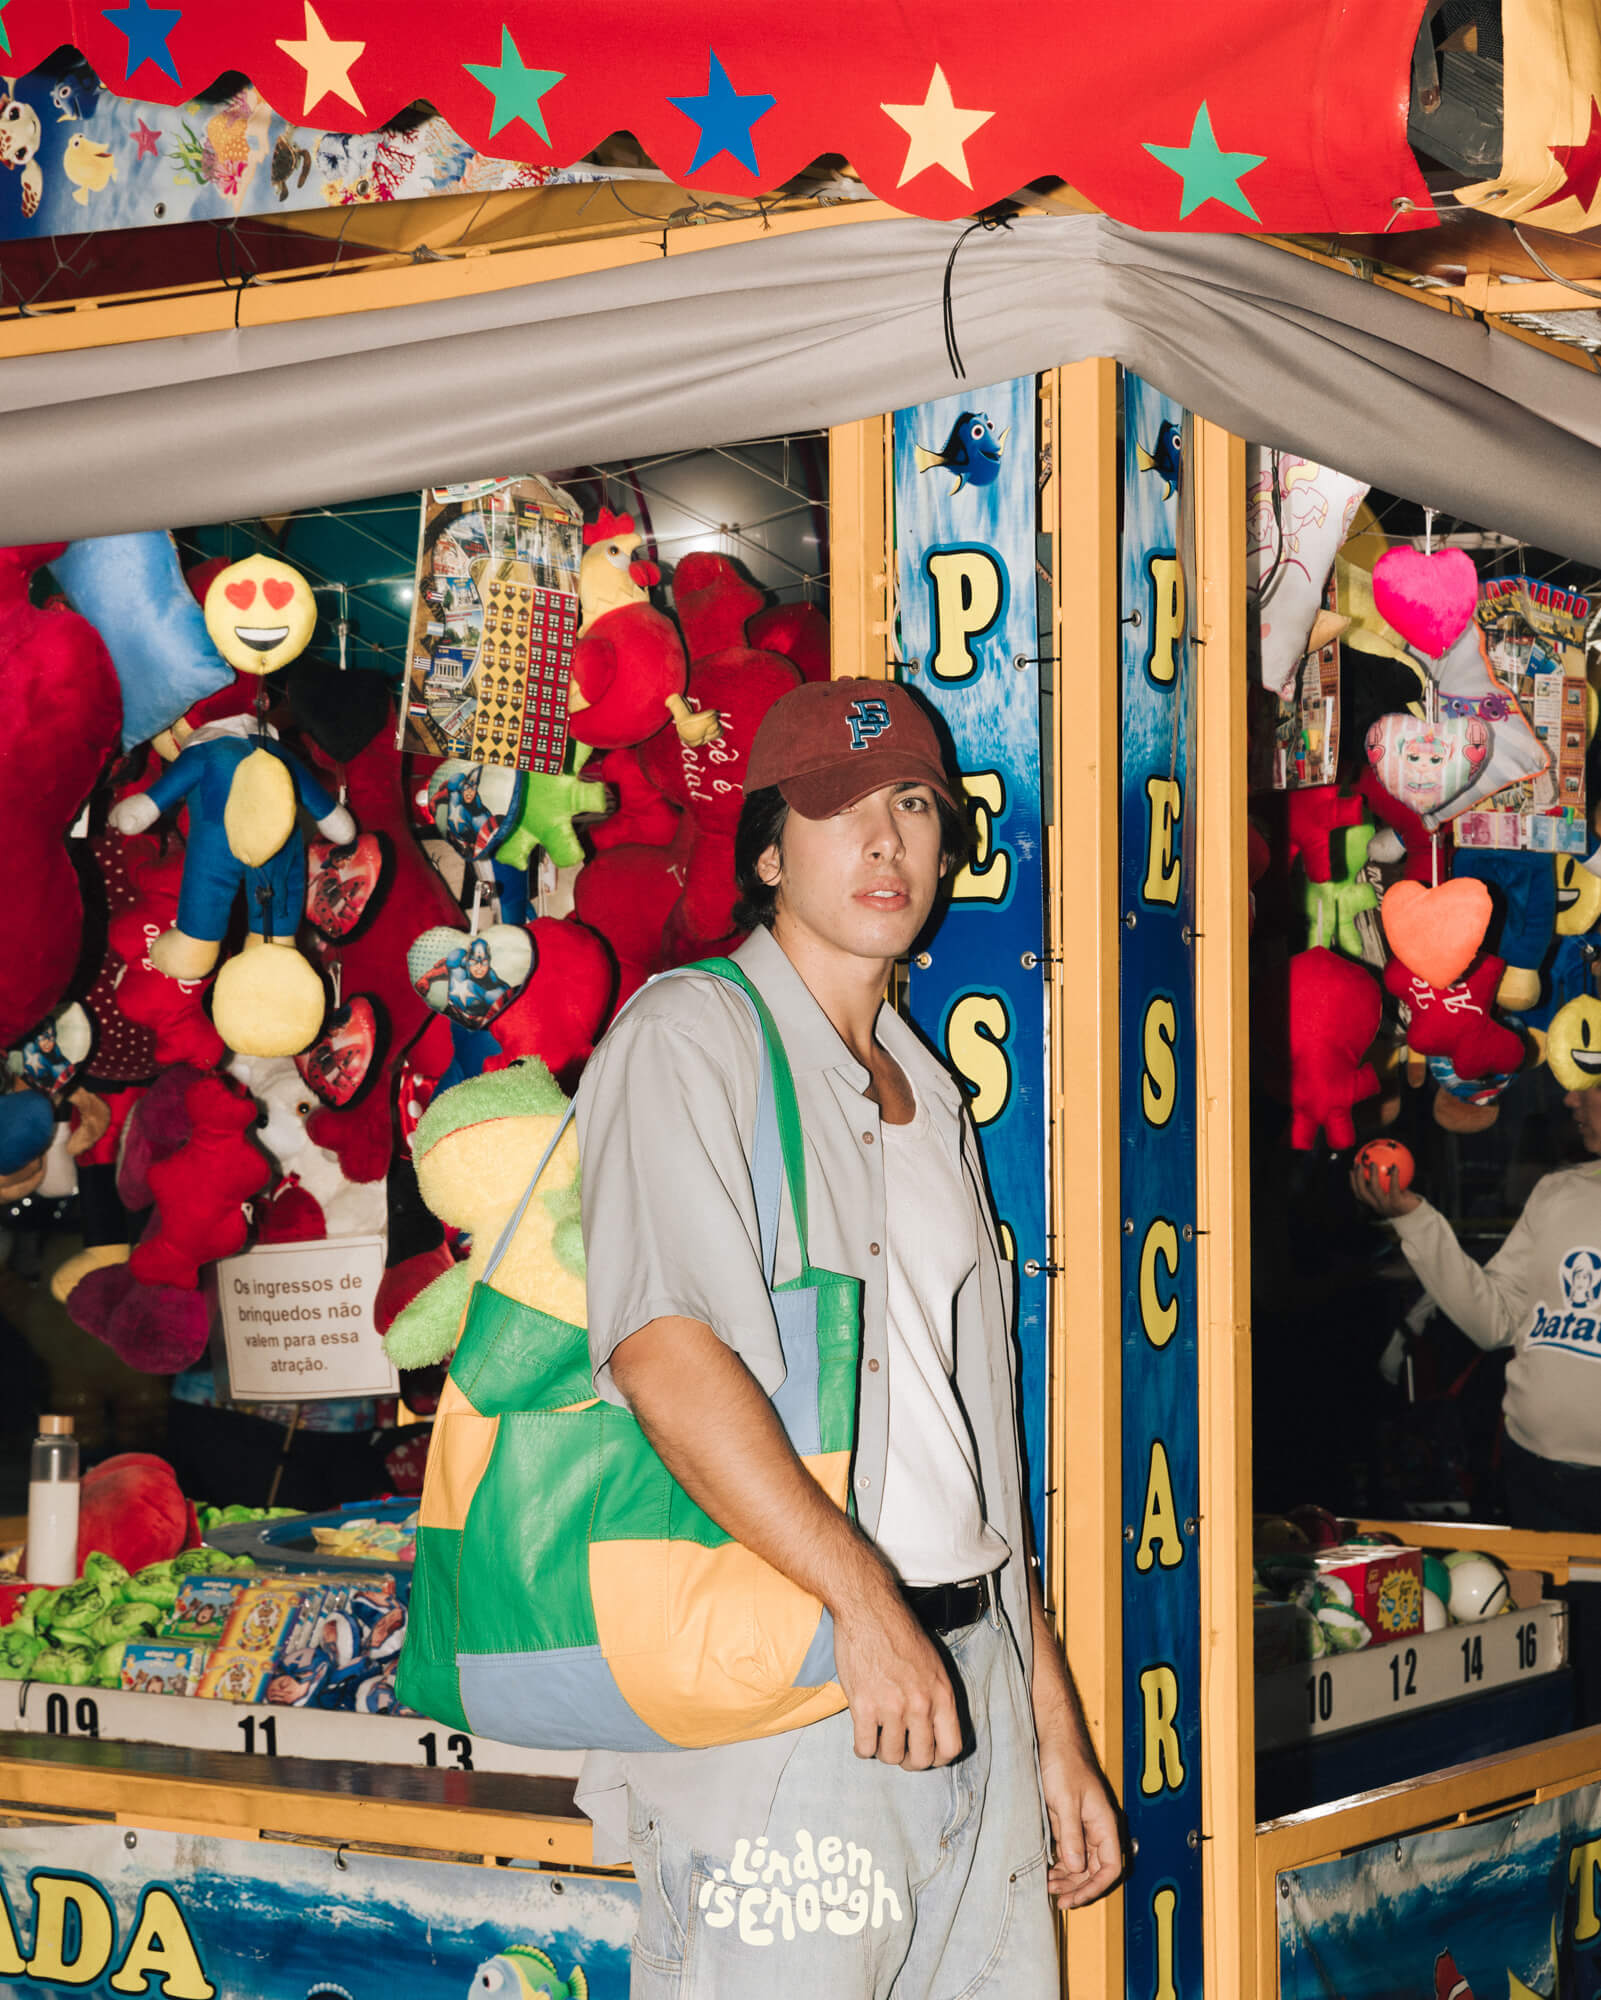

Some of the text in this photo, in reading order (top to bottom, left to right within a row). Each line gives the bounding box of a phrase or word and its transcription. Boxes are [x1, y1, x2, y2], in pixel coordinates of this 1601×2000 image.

[233, 1273, 363, 1299] Os ingressos de
[238, 1302, 362, 1326] brinquedos não
[1528, 1306, 1601, 1345] bata
[244, 1331, 359, 1350] valem para essa
[270, 1356, 328, 1375] atração.
[1460, 1634, 1484, 1684] 14
[1515, 1621, 1537, 1670] 16
[1389, 1647, 1417, 1702] 12
[46, 1692, 99, 1738] 09
[1306, 1670, 1333, 1724] 10
[237, 1714, 277, 1757] 11
[417, 1731, 475, 1771] 13
[0, 1870, 217, 2000] DA
